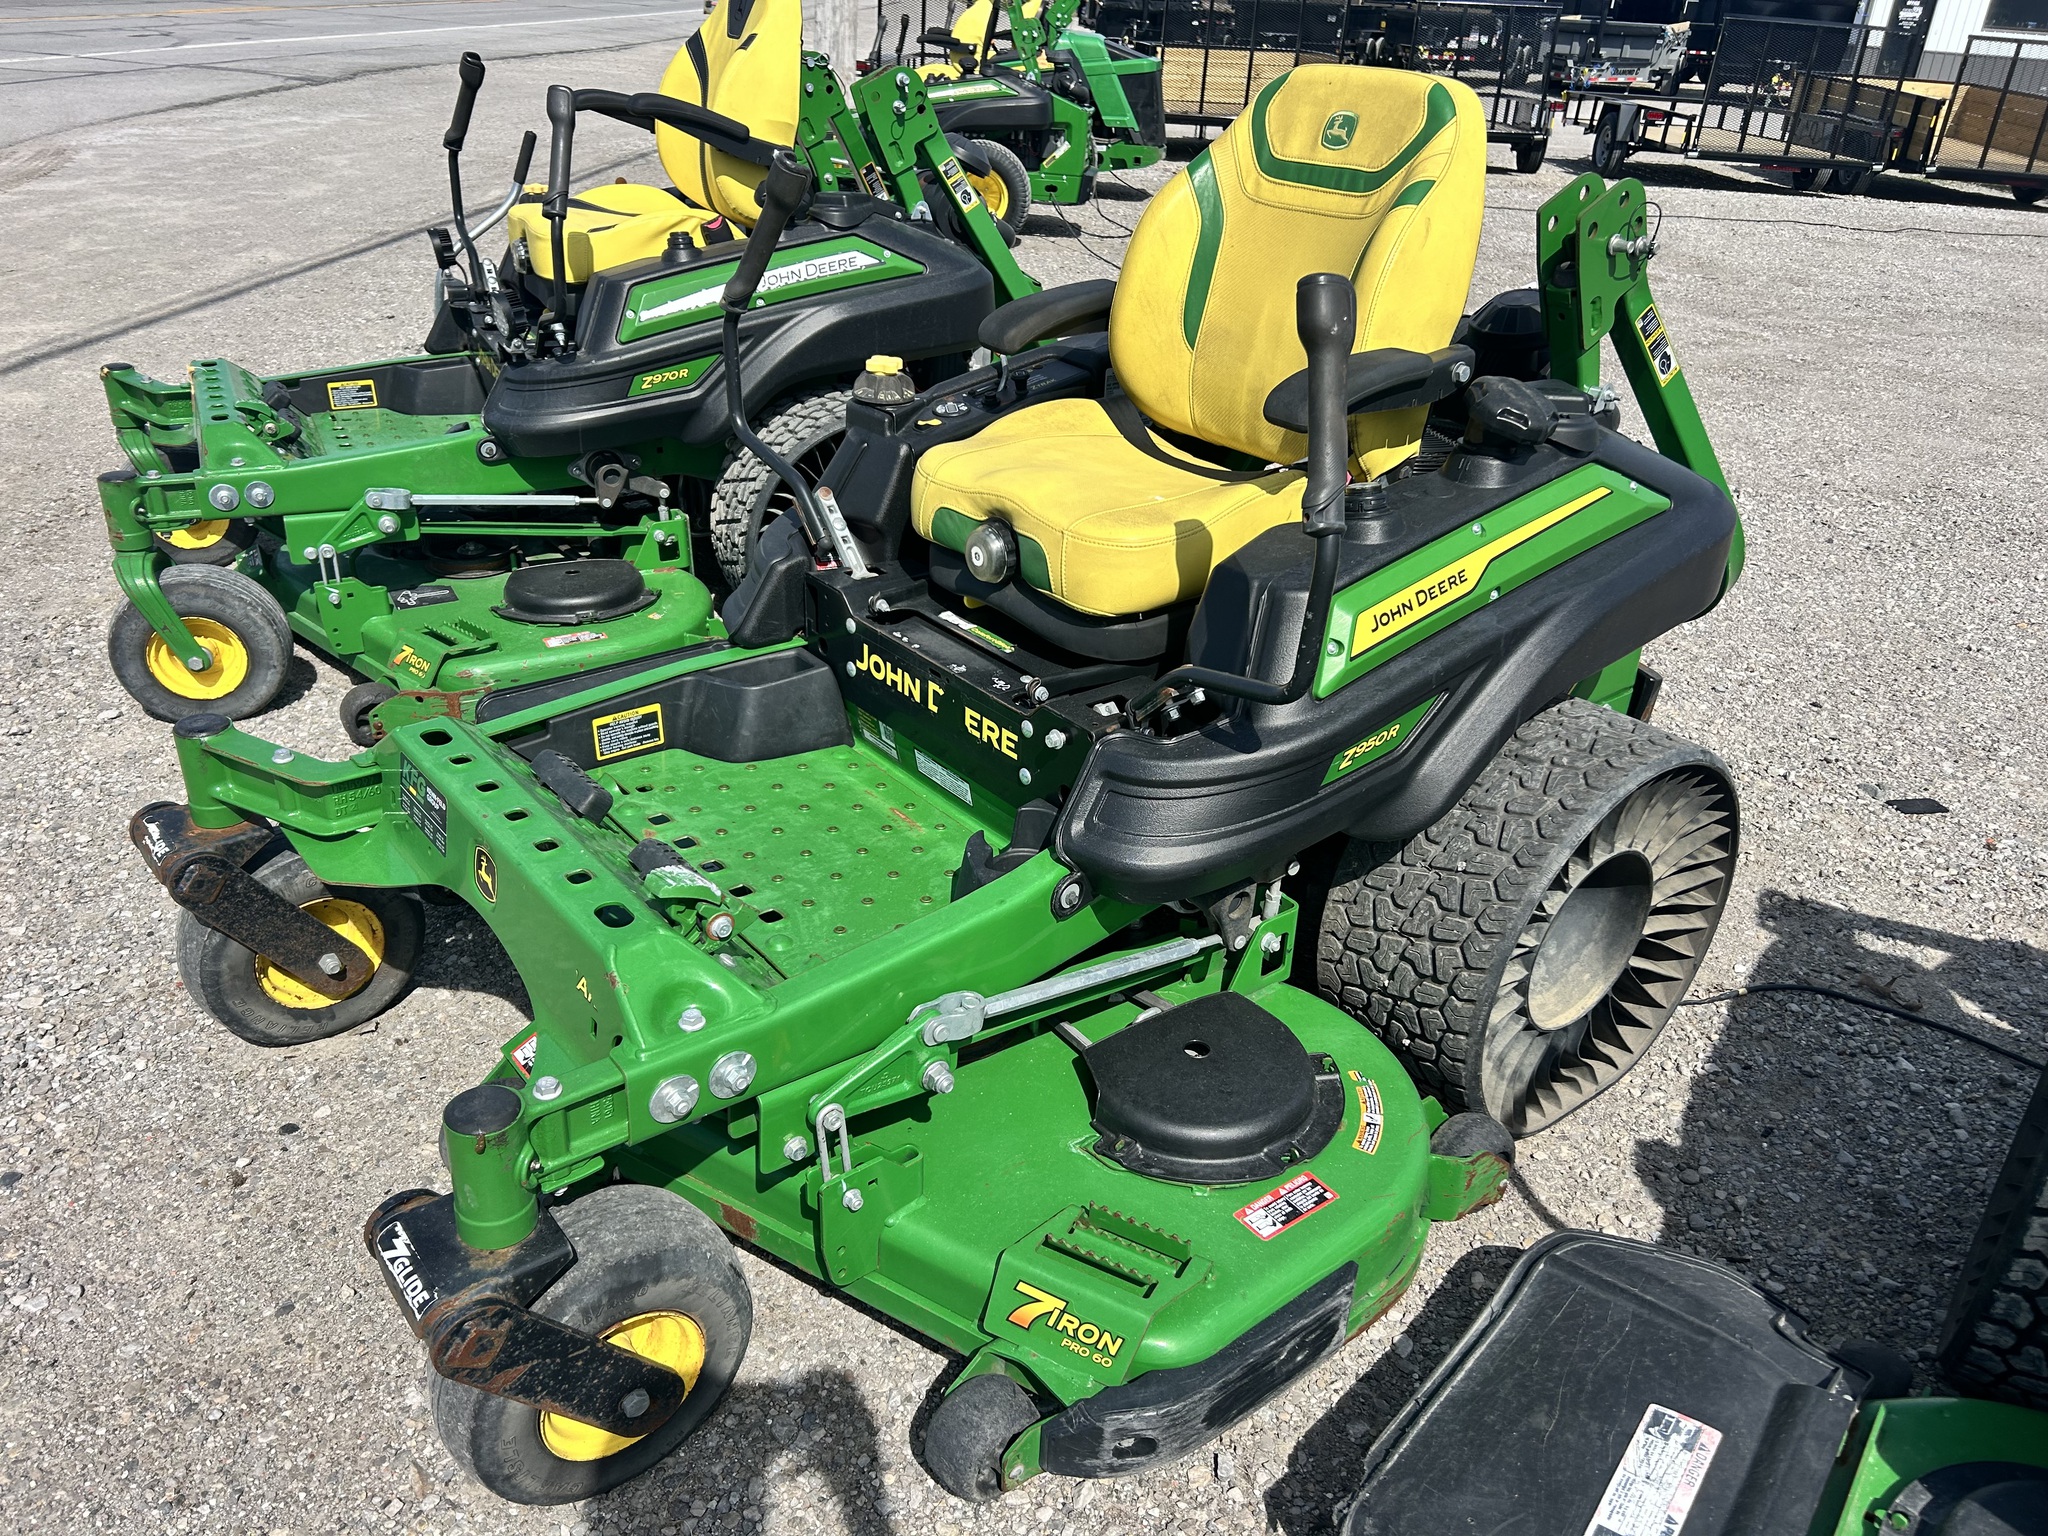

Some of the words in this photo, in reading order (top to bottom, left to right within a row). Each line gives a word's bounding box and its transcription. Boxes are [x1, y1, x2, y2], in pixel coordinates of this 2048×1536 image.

[761, 270, 801, 288] JOHN
[806, 256, 858, 278] DEERE
[641, 368, 689, 389] Z970R
[1371, 598, 1414, 633] JOHN
[1415, 569, 1468, 607] DEERE
[856, 643, 921, 703] JOHN
[616, 710, 640, 721] CAUTION
[1338, 723, 1400, 771] Z950R
[402, 759, 427, 798] KFG
[232, 998, 329, 1033] RELIANCE
[1060, 1337, 1091, 1358] PRO
[1091, 1352, 1114, 1369] 60
[501, 1434, 584, 1495] CARLISLE
[1684, 1450, 1708, 1489] DANGER
